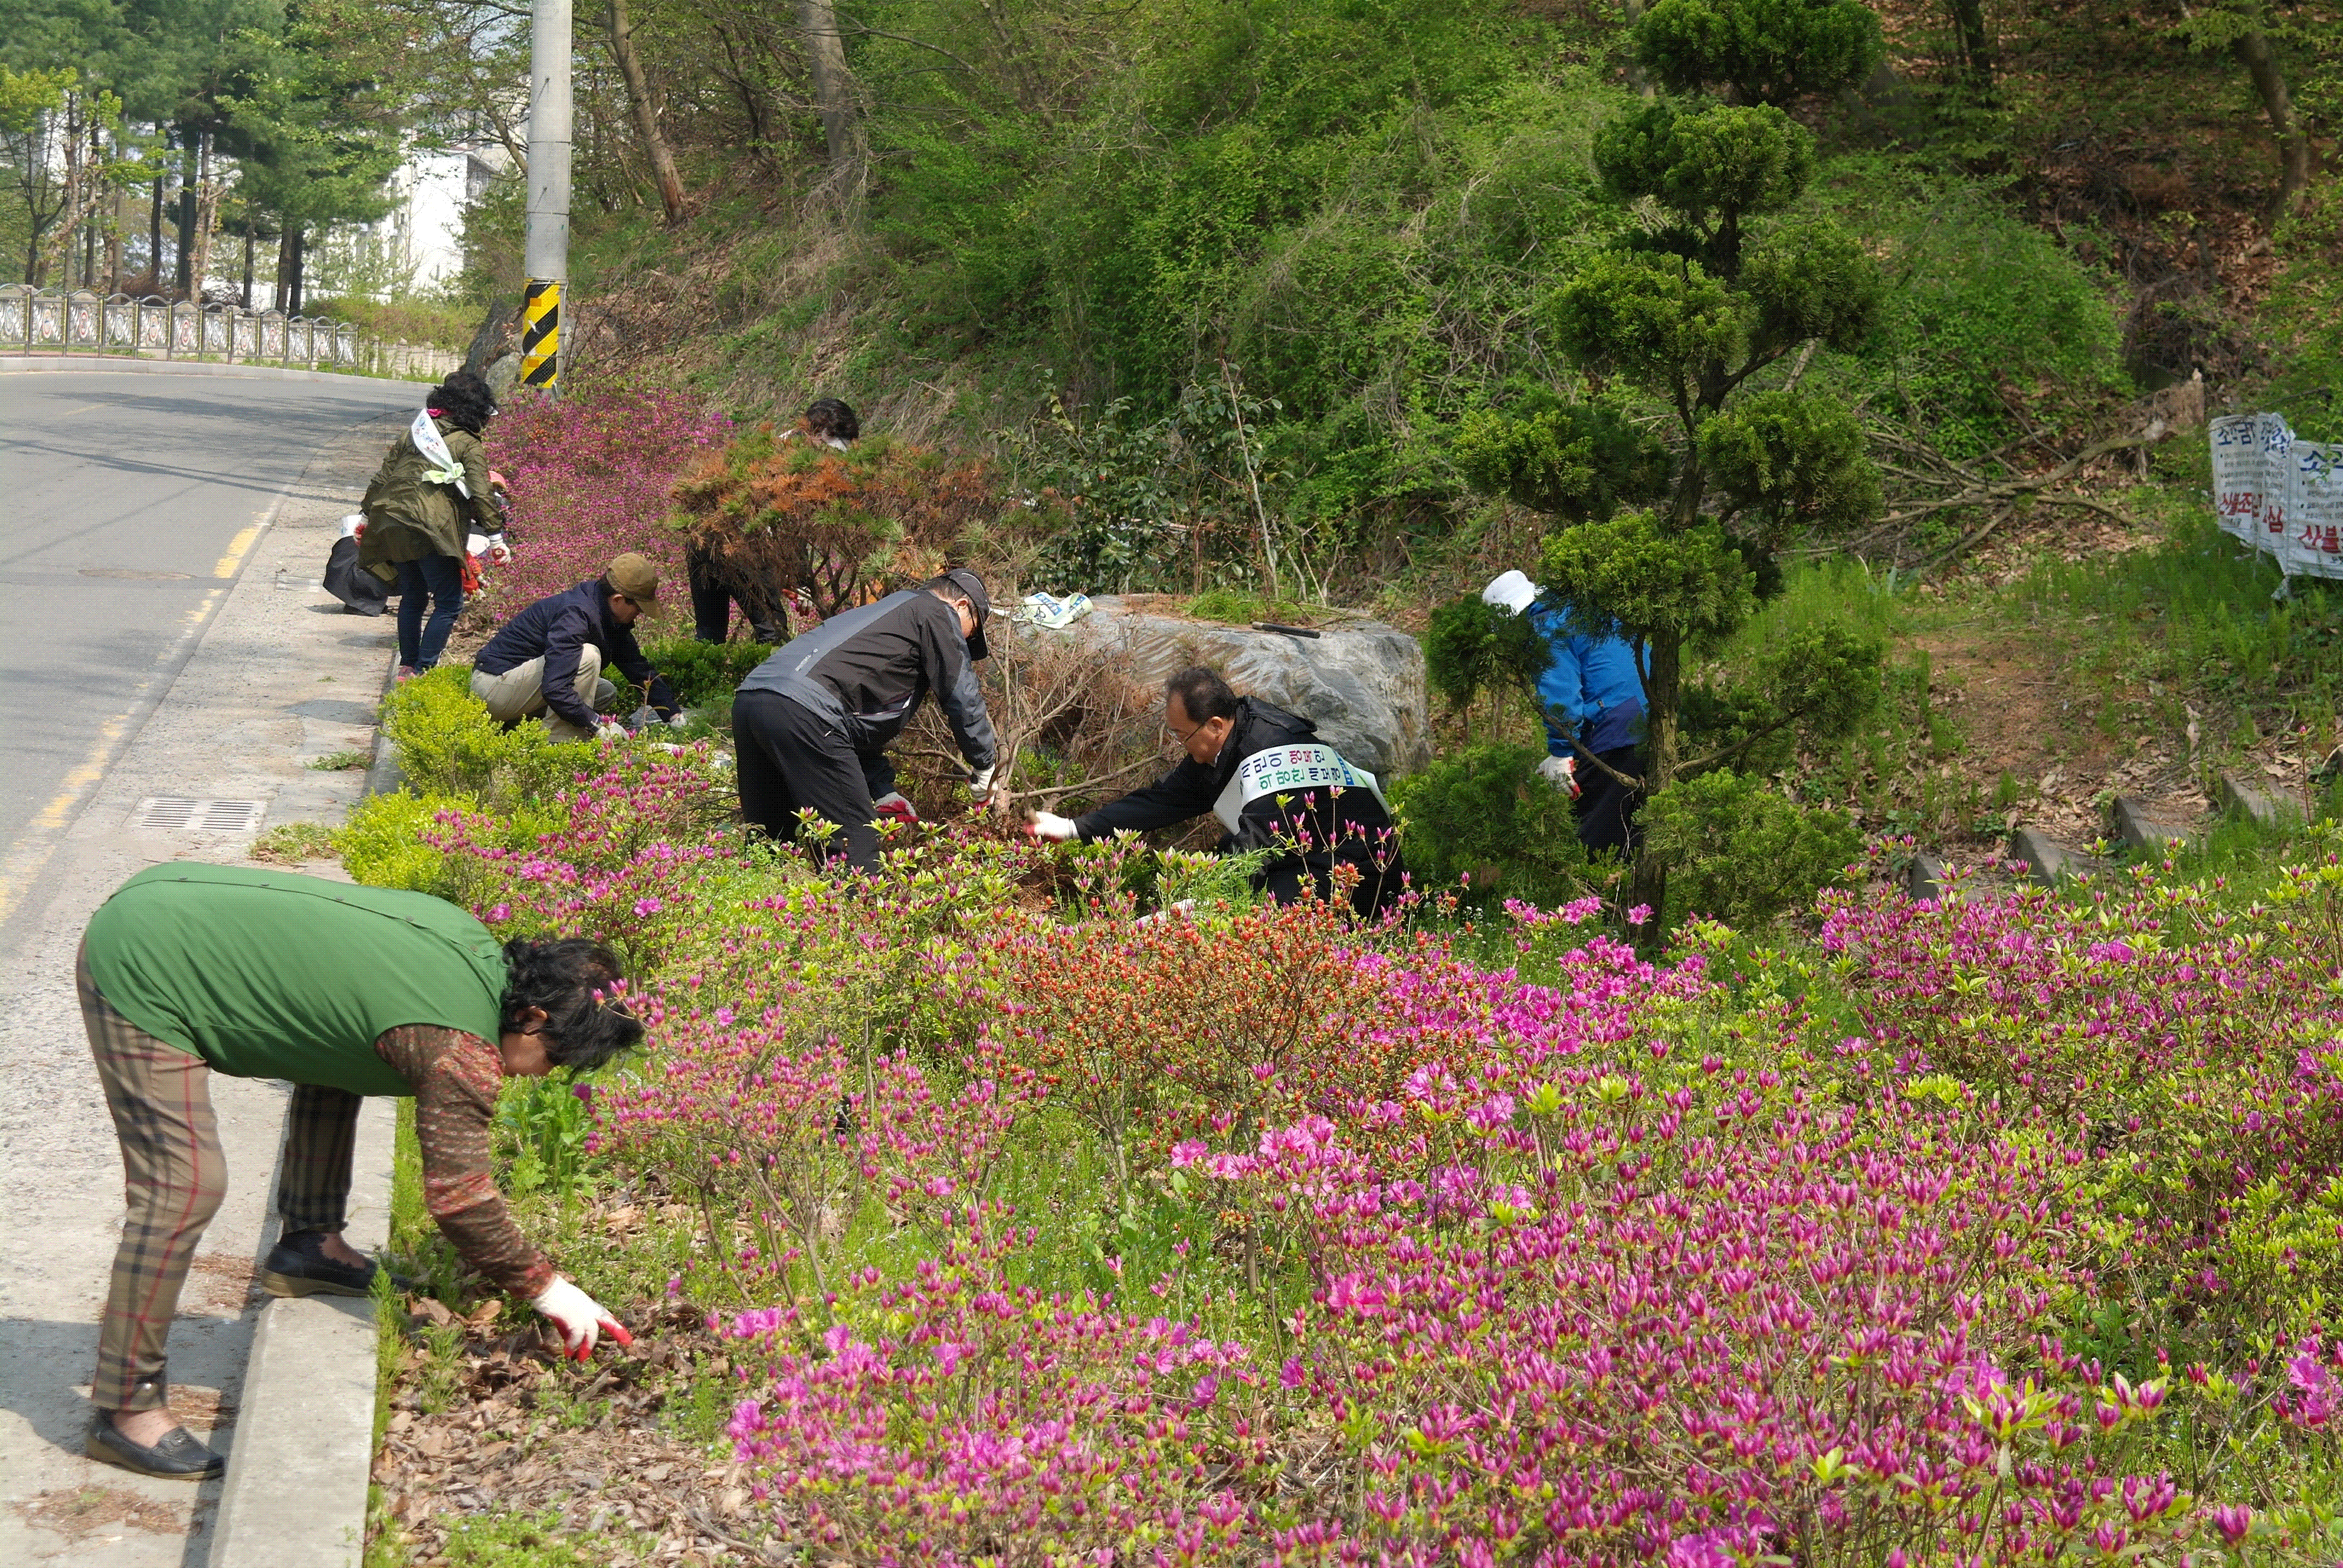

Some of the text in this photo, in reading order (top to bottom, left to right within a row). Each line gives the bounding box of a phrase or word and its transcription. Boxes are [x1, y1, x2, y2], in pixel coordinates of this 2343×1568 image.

[1241, 749, 1325, 778] 시민이 행복한
[1259, 768, 1305, 790] 희망찬
